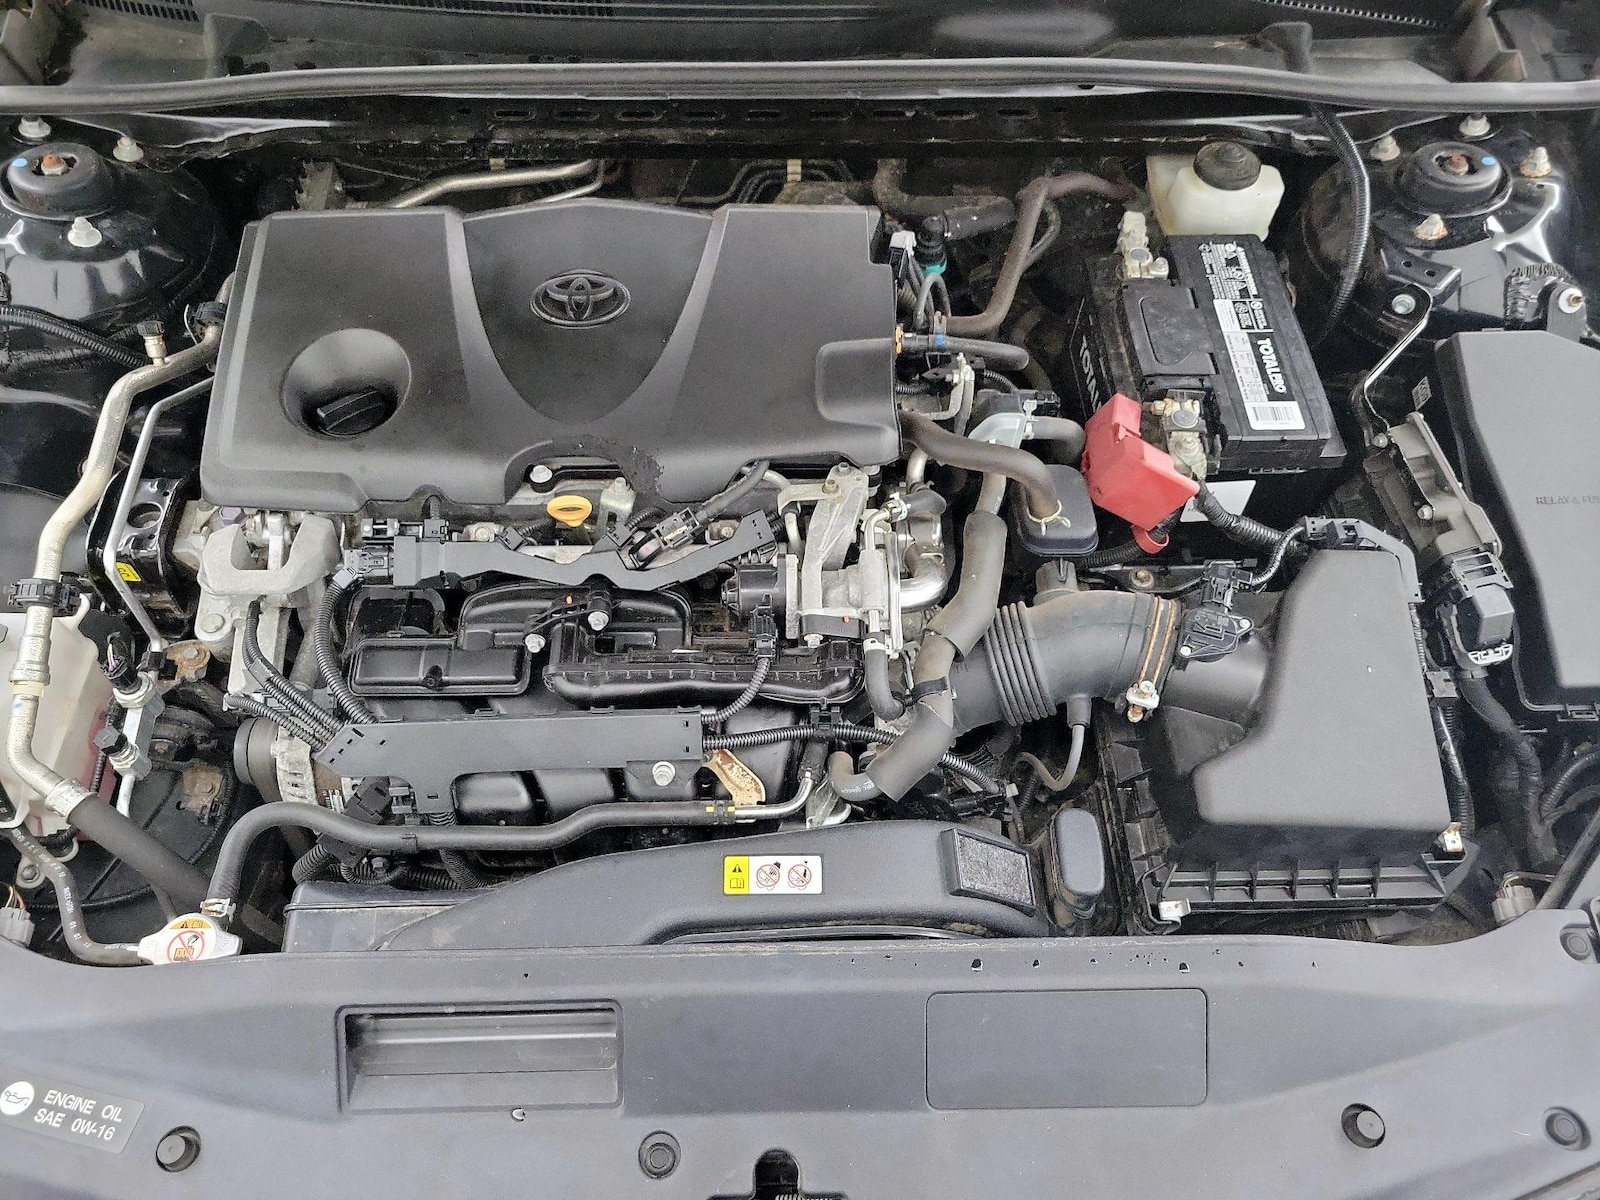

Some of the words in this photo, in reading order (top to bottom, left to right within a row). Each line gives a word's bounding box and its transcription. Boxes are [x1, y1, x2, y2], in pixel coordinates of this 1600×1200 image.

[1080, 335, 1102, 413] TOTAL
[1257, 337, 1287, 394] TOTALPRO
[1536, 495, 1569, 505] RELAY
[43, 1089, 96, 1115] ENGINE
[101, 1104, 124, 1123] OIL
[34, 1108, 66, 1128] SAE
[70, 1117, 116, 1141] 0W-16
